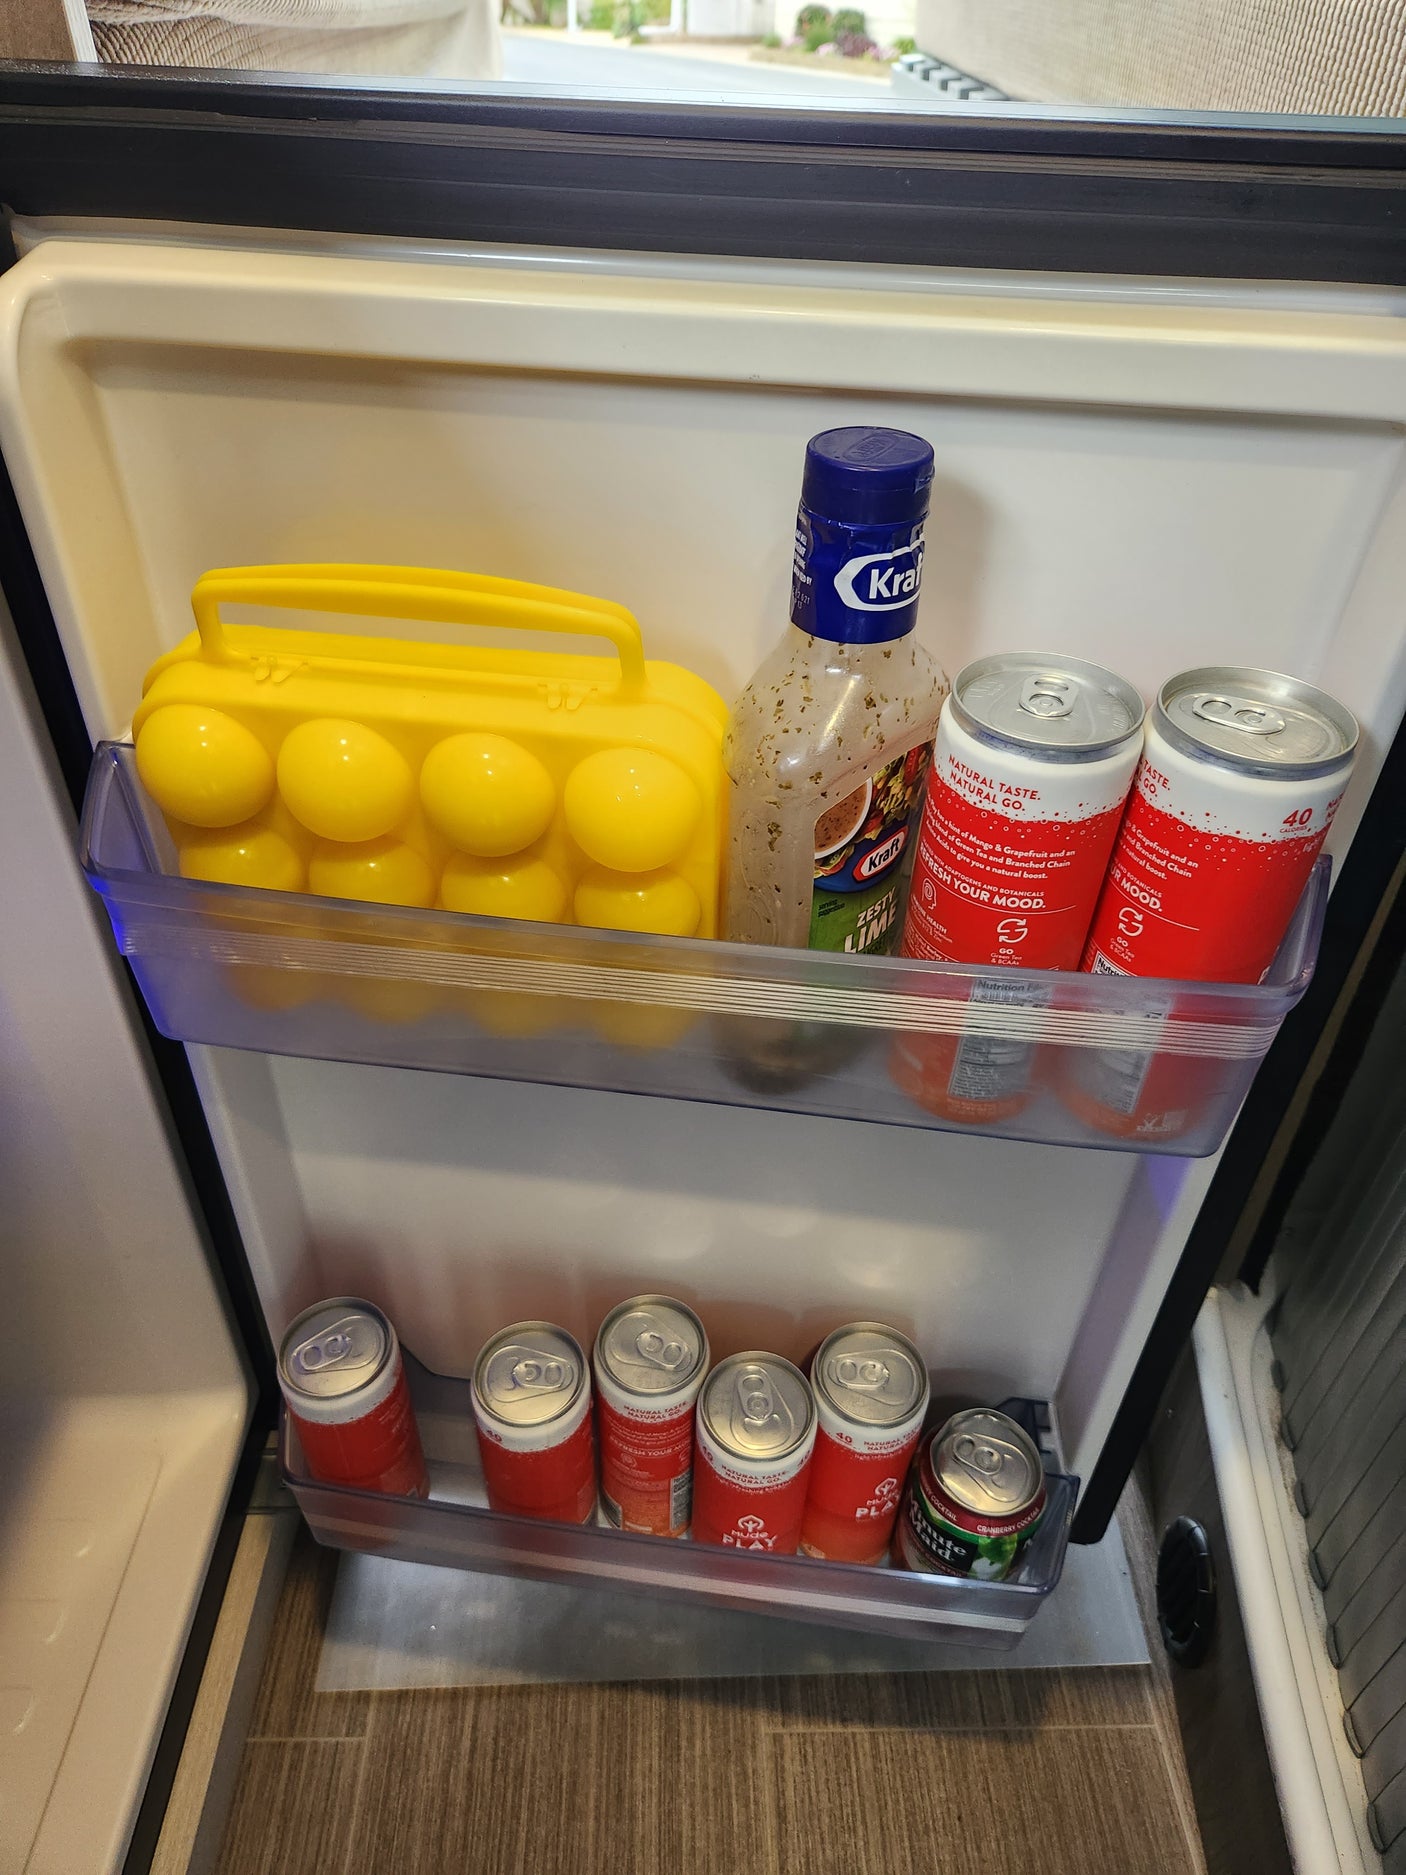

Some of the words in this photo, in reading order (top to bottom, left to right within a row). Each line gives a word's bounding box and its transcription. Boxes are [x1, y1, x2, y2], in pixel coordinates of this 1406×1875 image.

[868, 551, 923, 600] Kraf
[948, 753, 995, 789] NATURAL
[999, 781, 1041, 801] TASTE.
[950, 771, 998, 804] NATURAL
[1143, 759, 1171, 791] TASTE.
[1281, 807, 1313, 827] 40
[867, 837, 900, 873] Kraft
[955, 838, 975, 854] Green
[976, 848, 989, 860] Tea
[988, 854, 1005, 864] and
[1005, 857, 1047, 869] Branched
[1047, 860, 1072, 869] Chain
[961, 831, 970, 839] of
[969, 834, 994, 851] Mango
[995, 843, 1003, 852] &
[1003, 846, 1049, 859] Grapefruit
[1049, 849, 1066, 858] and
[1136, 829, 1170, 857] Grapefruit
[1170, 853, 1188, 865] and
[1187, 860, 1199, 869] an
[956, 852, 971, 864] give
[970, 860, 985, 868] you
[992, 867, 1022, 878] natural
[1023, 870, 1049, 879] boost.
[1135, 841, 1167, 867] Branched
[1167, 862, 1192, 879] Chain
[920, 840, 952, 886] REFRESH
[953, 877, 991, 903] YOUR
[992, 894, 1047, 909] MOOD.
[982, 883, 999, 892] AND
[999, 887, 1046, 898] BOTANICALS
[1120, 877, 1163, 912] MOOD.
[856, 886, 896, 928] ZESTY
[844, 899, 897, 954] LIME
[998, 947, 1015, 955] GO
[1116, 936, 1129, 947] GO
[977, 979, 1026, 992] Nutrition
[624, 1404, 662, 1415] NATURAL
[627, 1411, 667, 1420] NATURAL
[836, 1432, 853, 1443] 40
[863, 1437, 901, 1446] NATURAL
[721, 1464, 759, 1480] NATURAL
[725, 1472, 764, 1485] NATURAL
[930, 1494, 957, 1521] COCKTAIL
[722, 1533, 778, 1551] PLAY
[976, 1524, 1017, 1534] CRANBERRY
